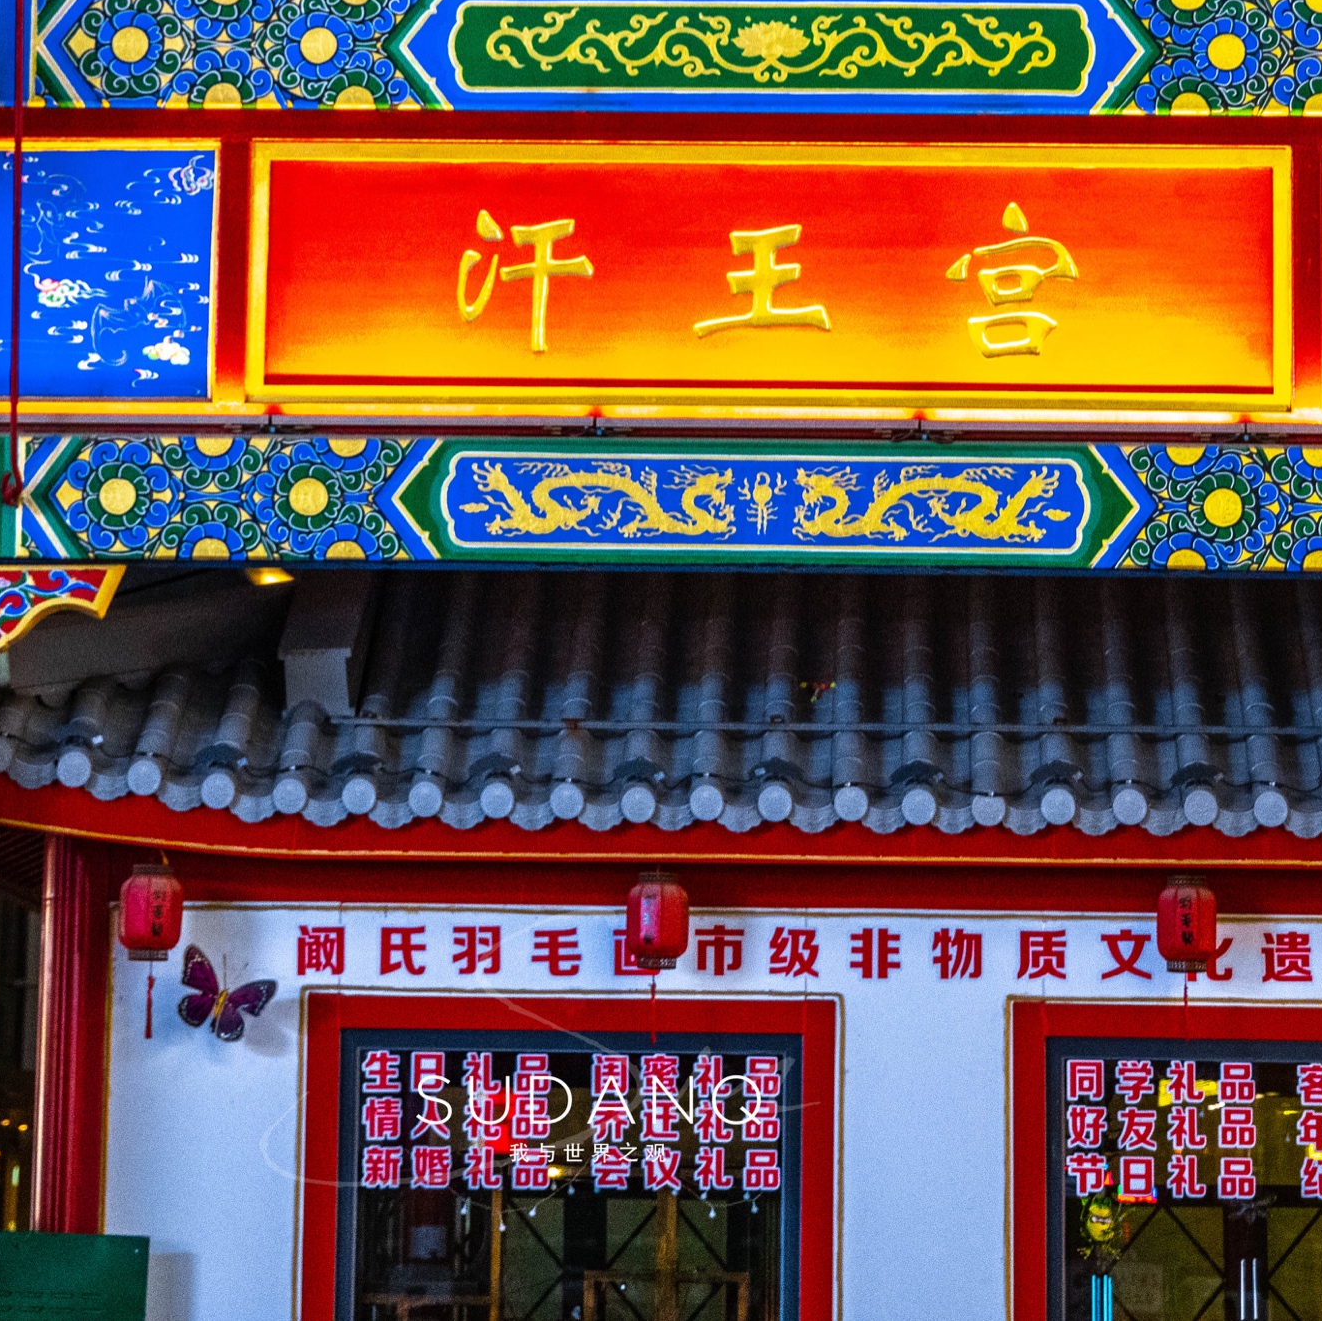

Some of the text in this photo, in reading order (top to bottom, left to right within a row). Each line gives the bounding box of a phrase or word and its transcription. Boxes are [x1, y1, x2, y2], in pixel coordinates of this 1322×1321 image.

[456, 201, 1078, 359] 汗王宫
[363, 1052, 779, 1095] 生日礼品 闺蜜礼品
[1069, 1061, 1255, 1101] 同学礼品
[1069, 1108, 1255, 1148] 好友礼品
[363, 1147, 779, 1188] 新婚礼品 会议礼品
[1069, 1154, 1255, 1197] 节日礼品
